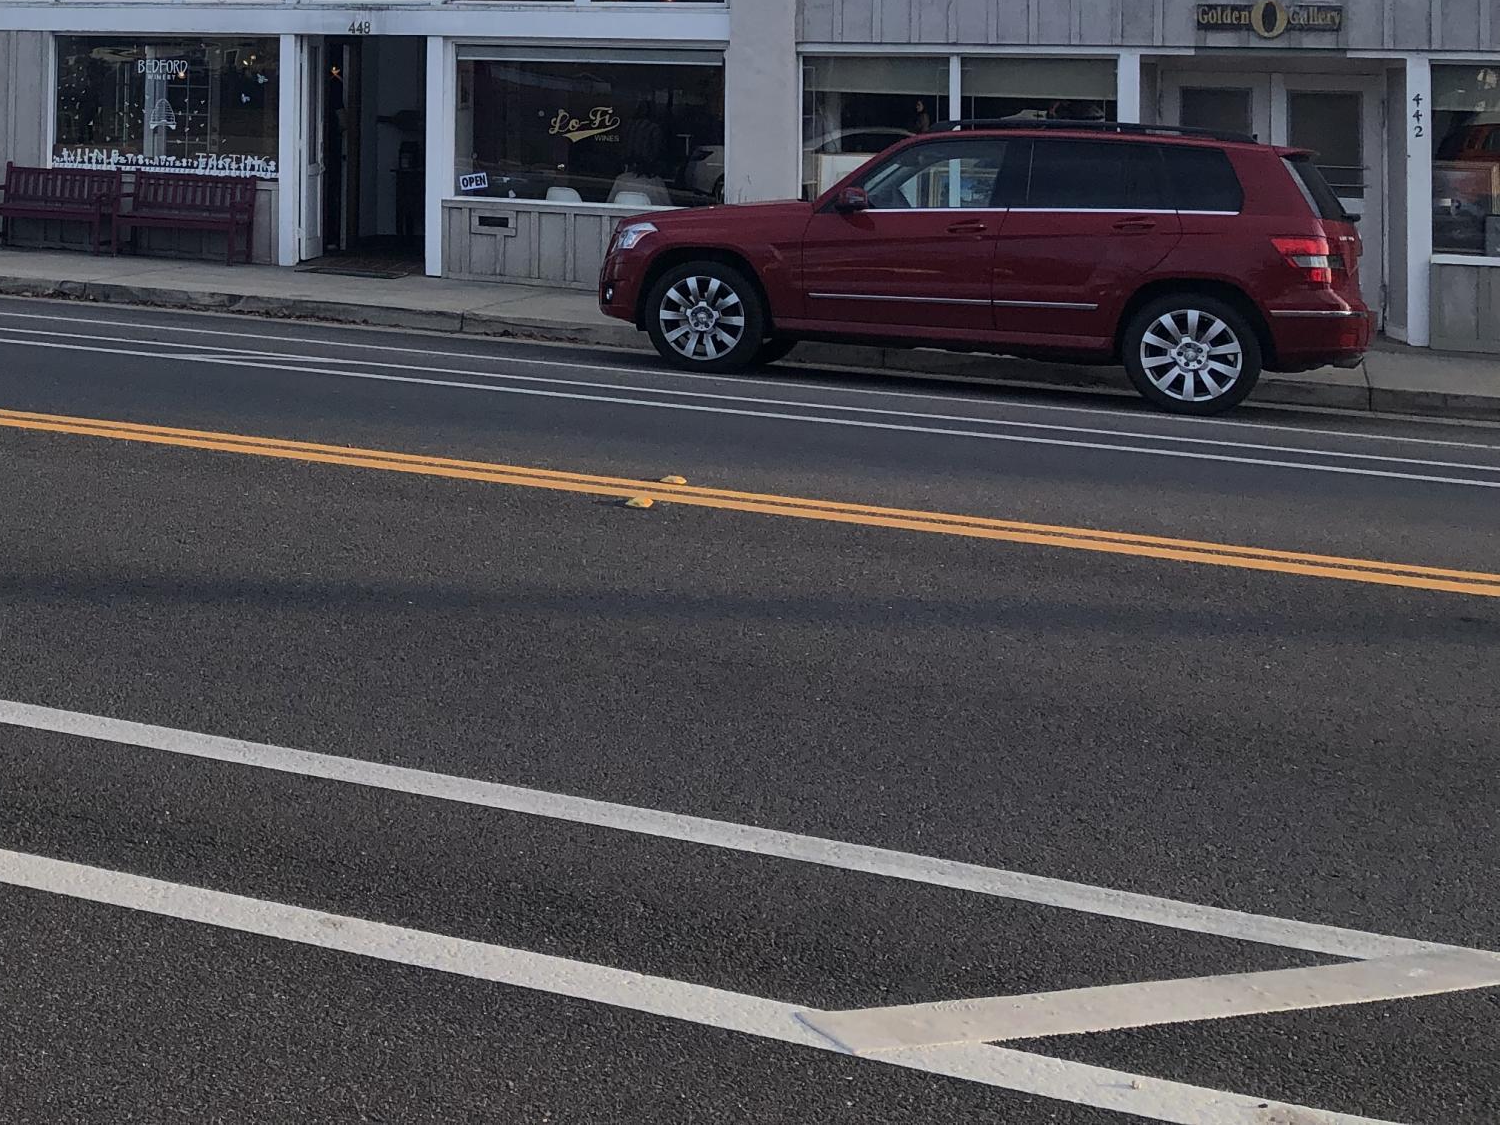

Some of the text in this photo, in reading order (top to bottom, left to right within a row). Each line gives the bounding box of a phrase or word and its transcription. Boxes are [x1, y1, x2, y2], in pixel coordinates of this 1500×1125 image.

[1198, 6, 1250, 25] Golden
[1289, 6, 1340, 29] Gallery
[348, 21, 370, 34] 448
[137, 59, 188, 74] BEDFORD
[548, 107, 620, 134] Lo-Fi
[1412, 93, 1424, 138] 442
[594, 134, 620, 142] WINES
[461, 174, 487, 188] OPEN
